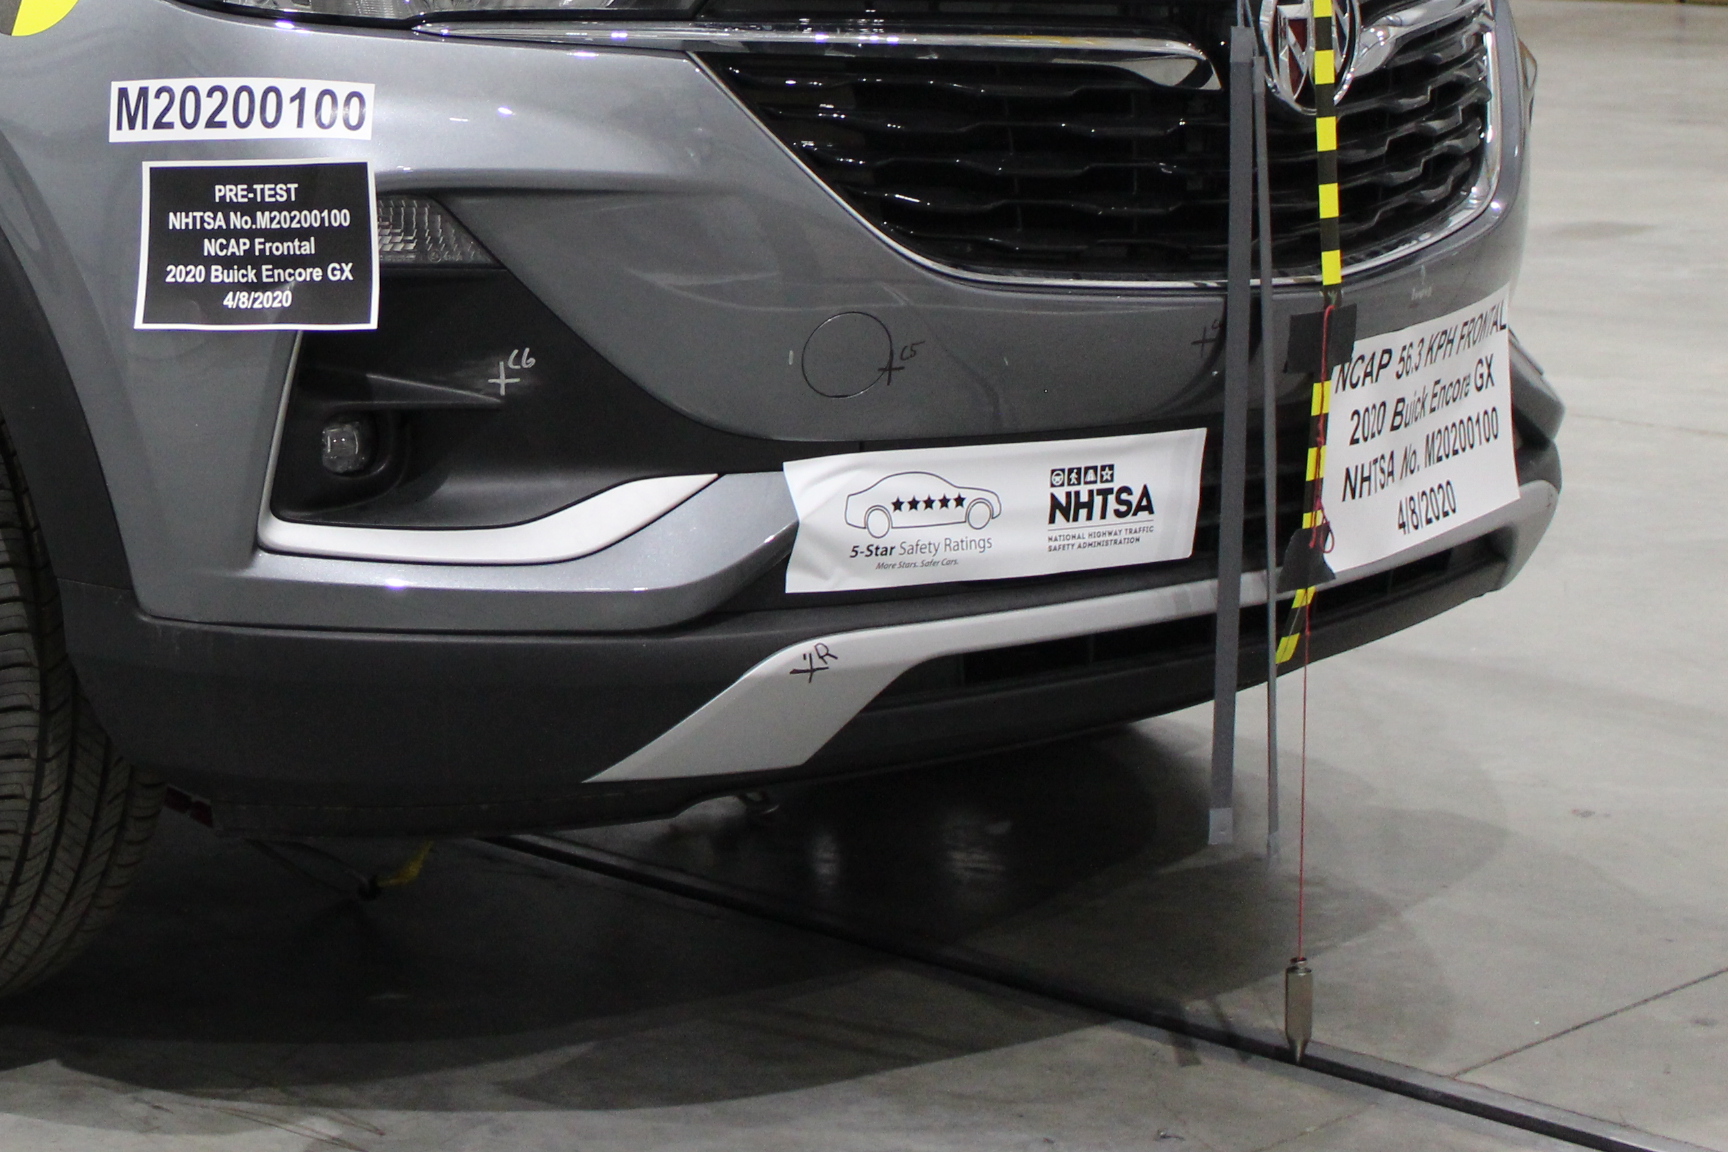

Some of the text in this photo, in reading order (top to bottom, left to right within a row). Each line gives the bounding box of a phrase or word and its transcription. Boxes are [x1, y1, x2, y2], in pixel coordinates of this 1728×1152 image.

[116, 84, 367, 132] M20200100
[214, 183, 299, 203] PRE-TEST
[168, 211, 226, 230] NHTSA
[203, 236, 315, 256] NCAP Frontal
[165, 262, 354, 283] 2020 Buick Encore GX
[222, 290, 293, 309] 4/8/2020
[1334, 299, 1507, 394] NCAP 56.3 KPH FRONTAL
[1349, 353, 1496, 446] 2020 Buick Encore GX
[1341, 406, 1500, 503] NHTSA No. M20200100
[1048, 483, 1155, 525] NHTSA
[1397, 479, 1458, 536] 4/8/2020
[1048, 525, 1154, 543] NATIONAL HIGHWAY TRAFFIC
[1048, 536, 1140, 552] SAFETY ADMINISTRATION
[849, 536, 993, 559] 5-Star Safety Ratings
[875, 557, 959, 570] More Stars. Safer Cars.
